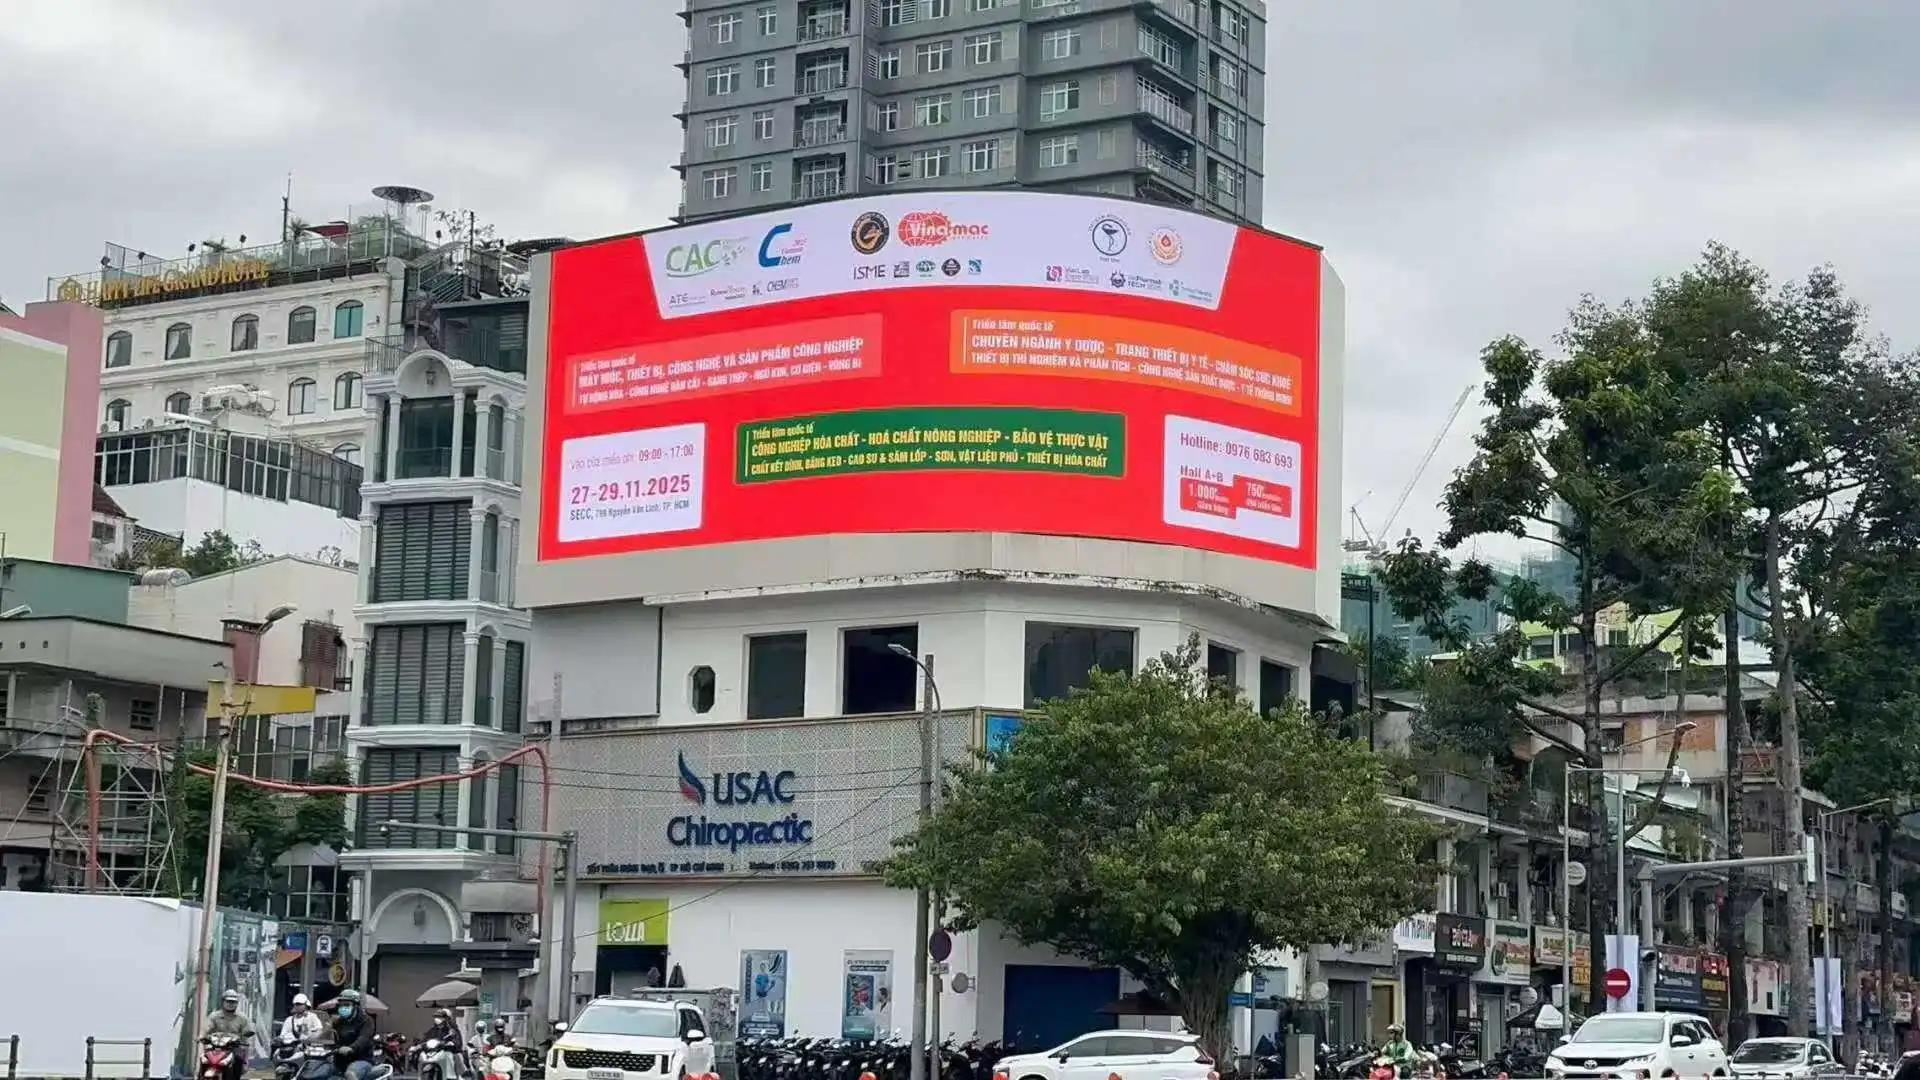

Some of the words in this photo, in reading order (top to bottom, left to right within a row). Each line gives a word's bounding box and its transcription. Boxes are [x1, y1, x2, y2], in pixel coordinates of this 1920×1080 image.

[665, 241, 721, 272] CAC
[853, 265, 886, 280] ISME
[668, 360, 694, 376] CÔNG
[723, 352, 736, 367] VÀ
[738, 349, 759, 365] SẢN
[761, 345, 790, 362] PHẨM
[792, 342, 821, 358] CÔNG
[824, 336, 864, 355] NGHIỆP
[972, 334, 1018, 348] CHUYÊN
[1021, 336, 1062, 351] NGÀNH
[1064, 339, 1072, 350] Y
[1115, 343, 1150, 359] TRANG
[1151, 347, 1178, 363] THIẾT
[1180, 353, 1189, 367] BỊ
[638, 448, 662, 462] 09:00
[671, 444, 694, 458] 17:00
[751, 442, 776, 457] CÔNG
[778, 439, 811, 455] NGHIỆP
[834, 432, 860, 448] CHẤT
[892, 427, 920, 444] CHẤT
[923, 429, 955, 443] NÔNG
[958, 429, 1001, 445] NGHIỆP
[1012, 428, 1036, 444] BẢO
[1039, 431, 1053, 447] VỆ
[1056, 433, 1085, 450] THỰC
[1088, 435, 1109, 451] VẬT
[1180, 433, 1223, 453] Hotline:
[1225, 442, 1250, 460] 0976
[1253, 450, 1272, 464] 683
[1274, 454, 1293, 469] 693
[848, 454, 864, 466] CAO
[866, 453, 877, 464] SU
[879, 453, 886, 463] &
[910, 448, 927, 462] LỐP
[958, 449, 975, 464] VẬT
[977, 450, 997, 464] LIỆU
[1027, 451, 1052, 465] THIẾT
[1053, 454, 1062, 468] BỊ
[1084, 454, 1108, 469] CHẤT
[571, 475, 691, 505] 27-29.11.2025
[570, 510, 594, 521] SECC,
[713, 770, 796, 805] USAC
[667, 813, 813, 854] Chiropractic
